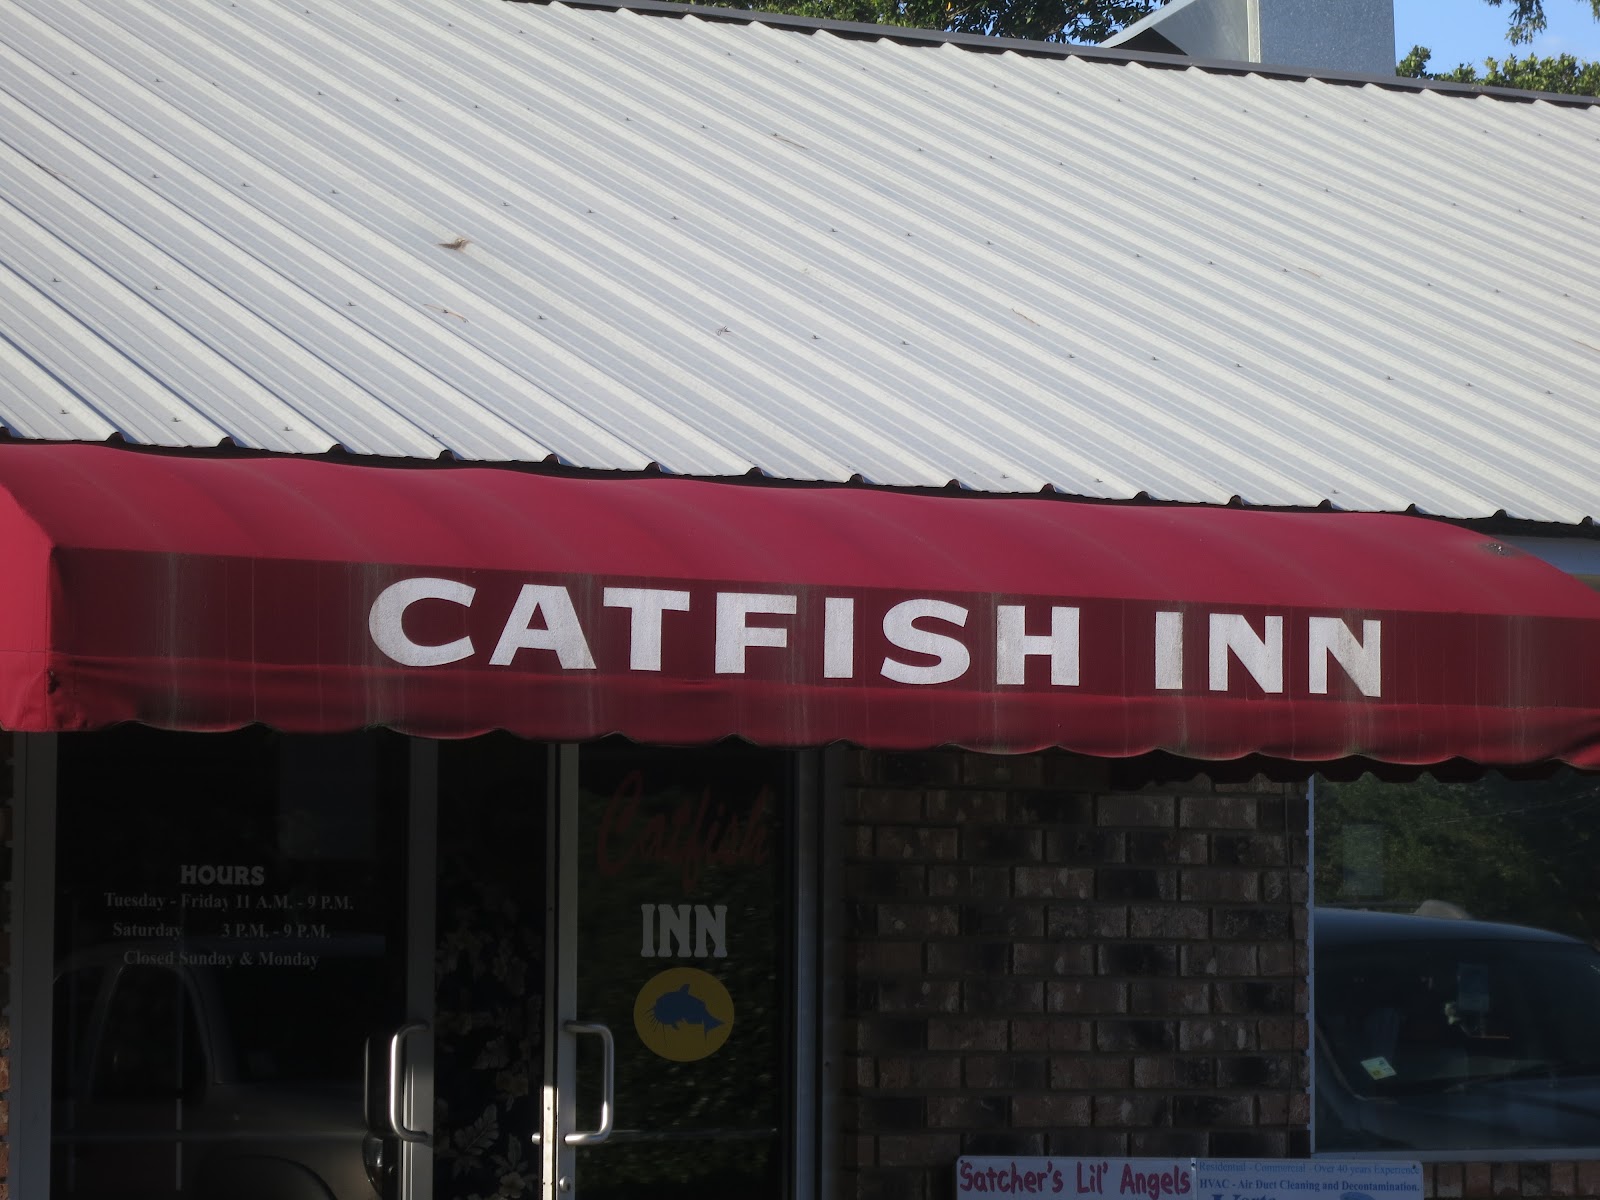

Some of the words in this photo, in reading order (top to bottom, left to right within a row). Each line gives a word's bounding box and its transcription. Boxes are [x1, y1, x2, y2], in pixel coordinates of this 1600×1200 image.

[368, 577, 1080, 686] CATFISH
[1155, 611, 1382, 697] INN
[597, 768, 770, 896] Catfish
[180, 865, 265, 886] HOURS
[104, 892, 165, 911] Tuesday
[181, 893, 228, 912] Friday
[236, 895, 249, 909] 11
[256, 895, 293, 910] A.M.
[307, 895, 316, 910] 9
[321, 896, 354, 911] P.M.
[113, 922, 183, 941] Saturday
[222, 923, 230, 938] 3
[235, 924, 269, 939] P.M.
[283, 924, 292, 938] 9
[297, 924, 331, 939] P.M.
[641, 904, 728, 957] INN
[123, 950, 174, 966] Closed
[179, 951, 233, 969] Sunday
[240, 952, 253, 966] &
[259, 952, 319, 970] Monday
[1199, 1162, 1246, 1173] Residential
[1254, 1163, 1306, 1174] Commercial
[1314, 1164, 1335, 1174] Over
[1337, 1164, 1348, 1174] 40
[1350, 1165, 1372, 1176] years
[960, 1160, 1064, 1194] Satcher's
[1076, 1161, 1109, 1194] Lil'
[1120, 1163, 1191, 1200] Angels
[1199, 1179, 1229, 1189] HVAC
[1238, 1180, 1253, 1189] Air
[1256, 1180, 1277, 1190] Duct
[1279, 1181, 1320, 1192] Cleaning
[1323, 1181, 1339, 1191] and
[1342, 1181, 1420, 1192] Decontamination.
